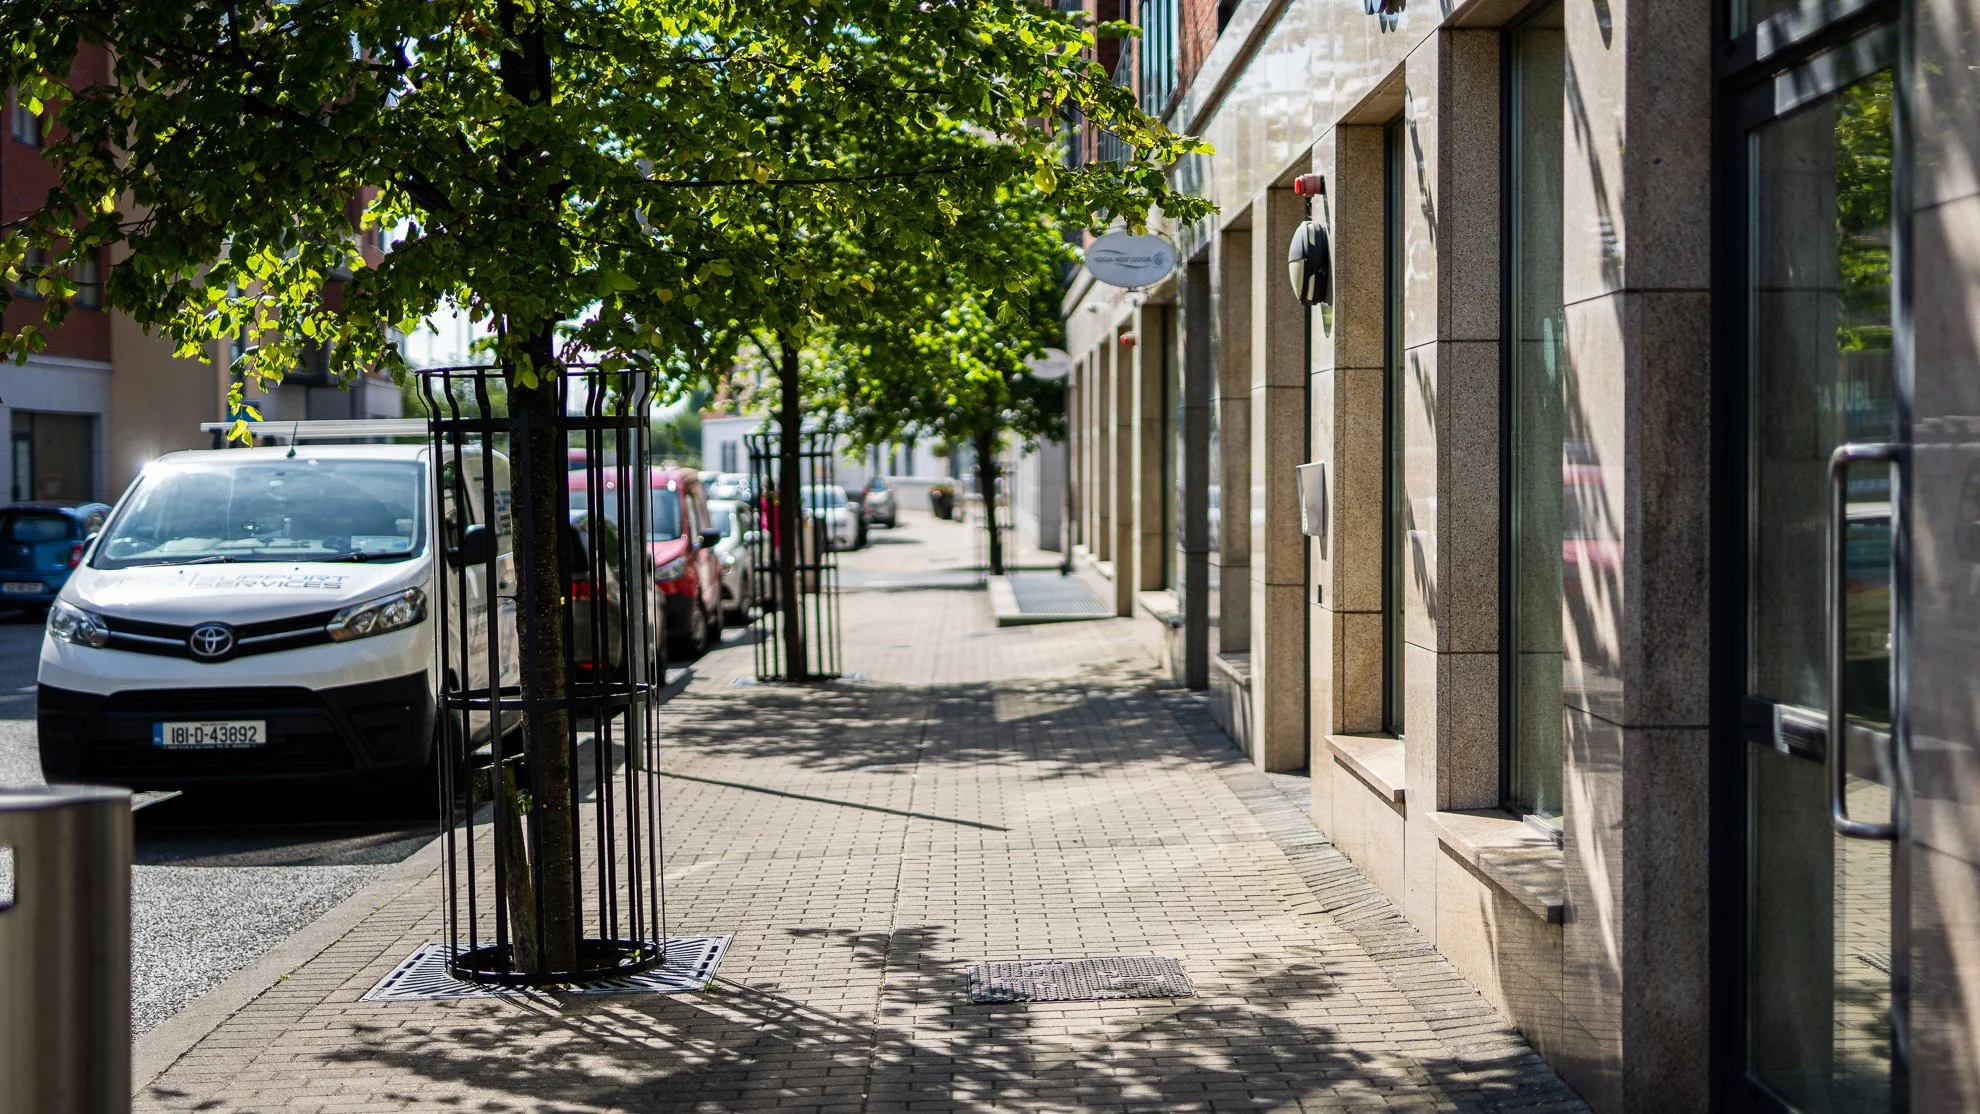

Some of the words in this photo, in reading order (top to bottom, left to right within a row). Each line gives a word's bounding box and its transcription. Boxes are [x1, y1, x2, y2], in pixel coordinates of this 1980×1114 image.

[197, 573, 350, 582] SUPPORT
[195, 580, 342, 589] SERVICES
[171, 725, 257, 744] 181-D-43892
